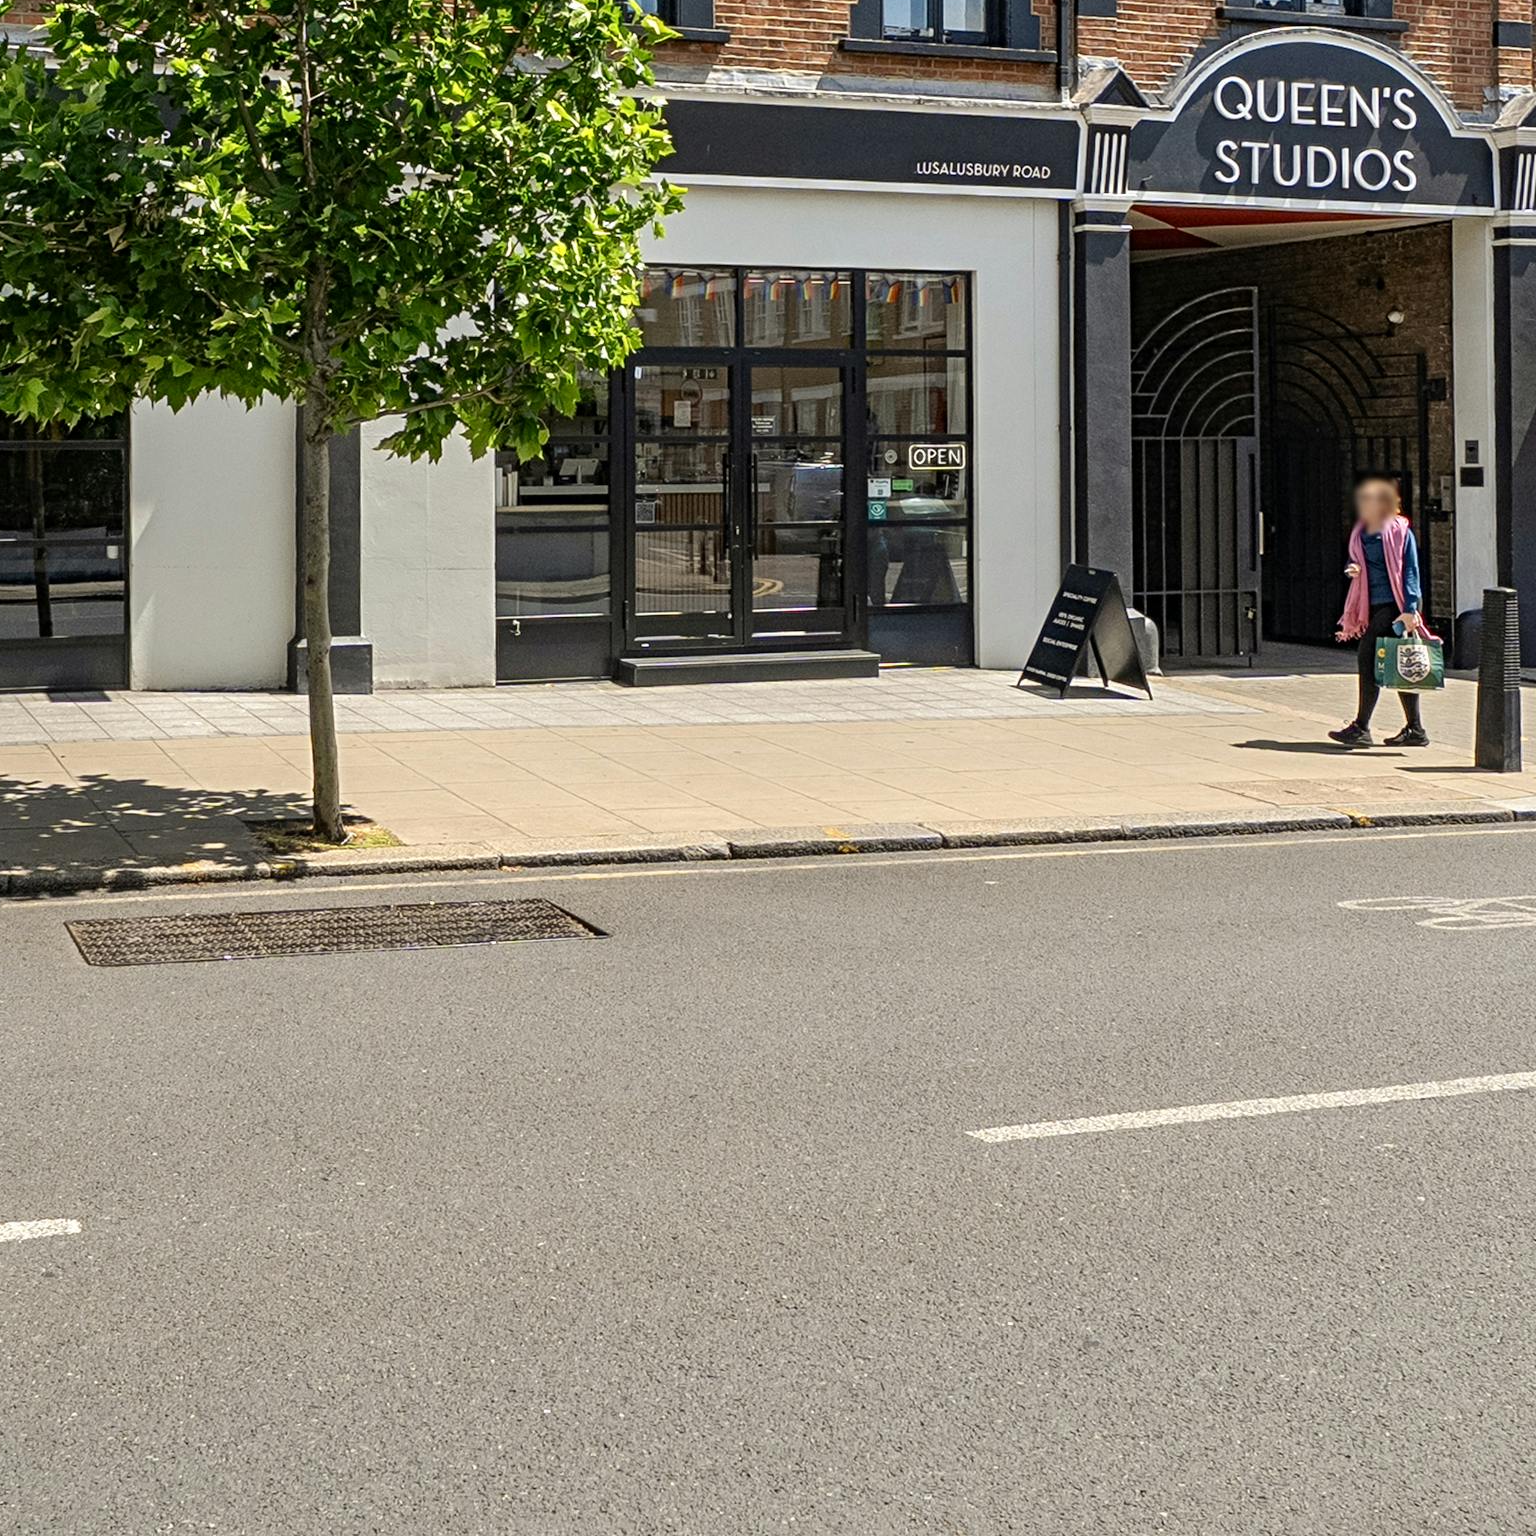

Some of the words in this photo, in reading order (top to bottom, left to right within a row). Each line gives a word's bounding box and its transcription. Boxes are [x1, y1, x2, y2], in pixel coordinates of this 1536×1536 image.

[1214, 76, 1418, 130] QUEEN'S
[1012, 164, 1051, 179] ROAD
[1214, 140, 1418, 192] STUDIOS
[913, 448, 961, 465] OPEN
